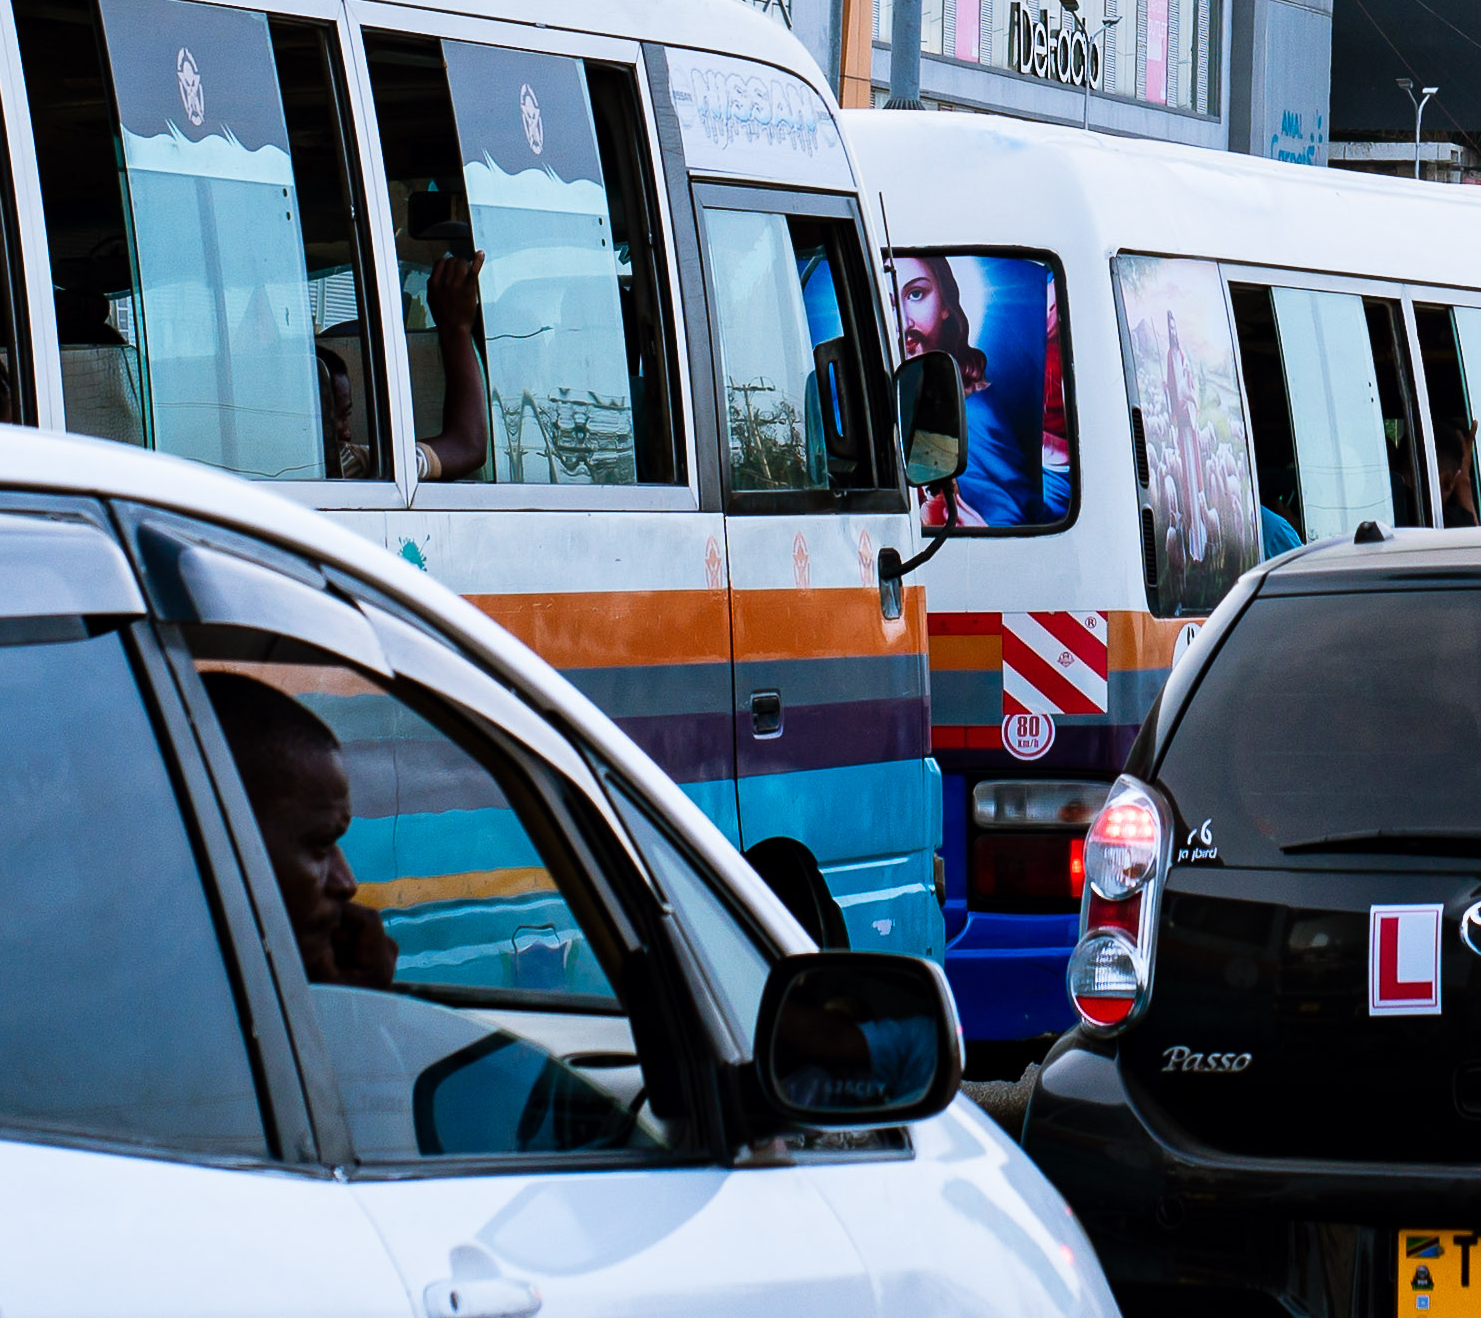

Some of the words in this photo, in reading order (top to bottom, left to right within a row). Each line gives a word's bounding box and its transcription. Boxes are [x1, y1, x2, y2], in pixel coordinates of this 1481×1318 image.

[1016, 715, 1041, 738] 80
[1377, 916, 1435, 1004] L
[1160, 1045, 1253, 1073] Passo
[1452, 1234, 1479, 1289] T
